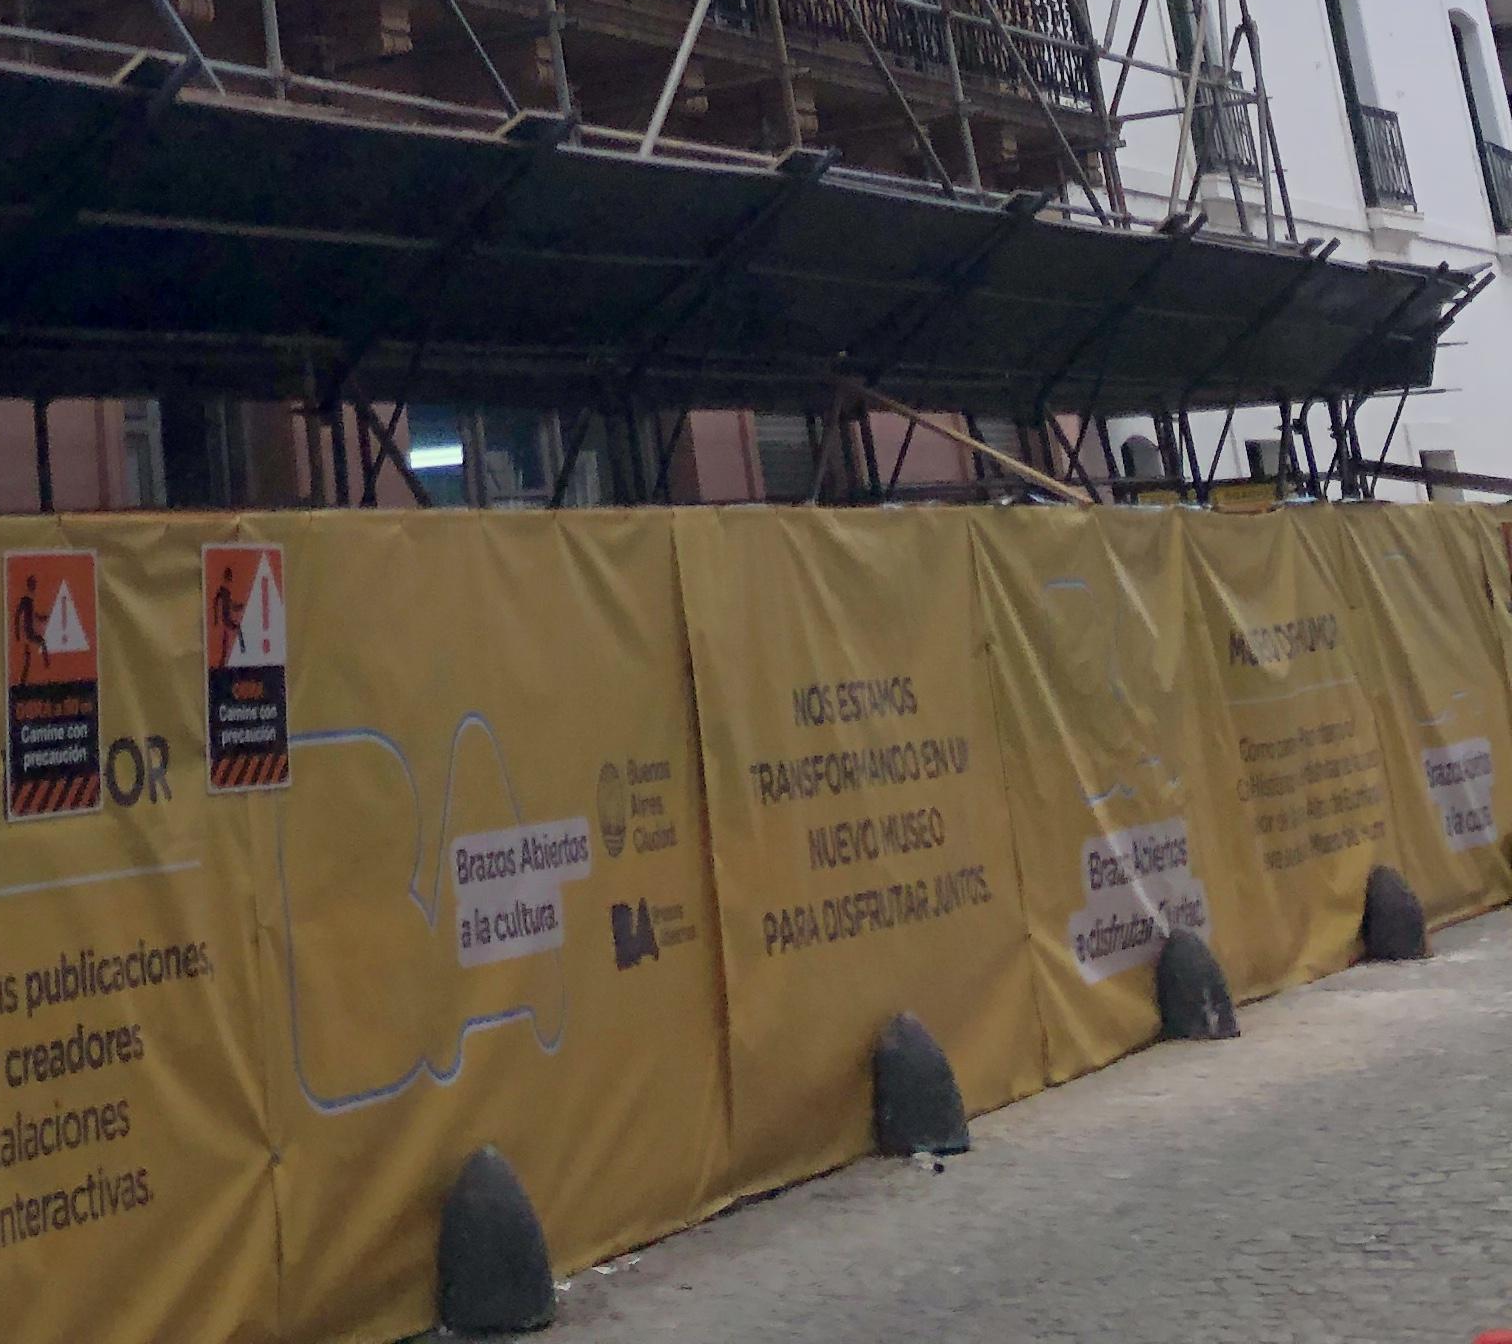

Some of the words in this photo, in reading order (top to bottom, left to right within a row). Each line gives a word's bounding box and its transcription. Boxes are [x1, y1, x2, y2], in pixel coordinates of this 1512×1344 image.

[455, 847, 517, 885] Brazos
[519, 832, 589, 874] Abiertos
[461, 919, 472, 949] a
[474, 906, 491, 945] la
[493, 898, 559, 942] cultura.
[5, 1022, 145, 1089] creadores
